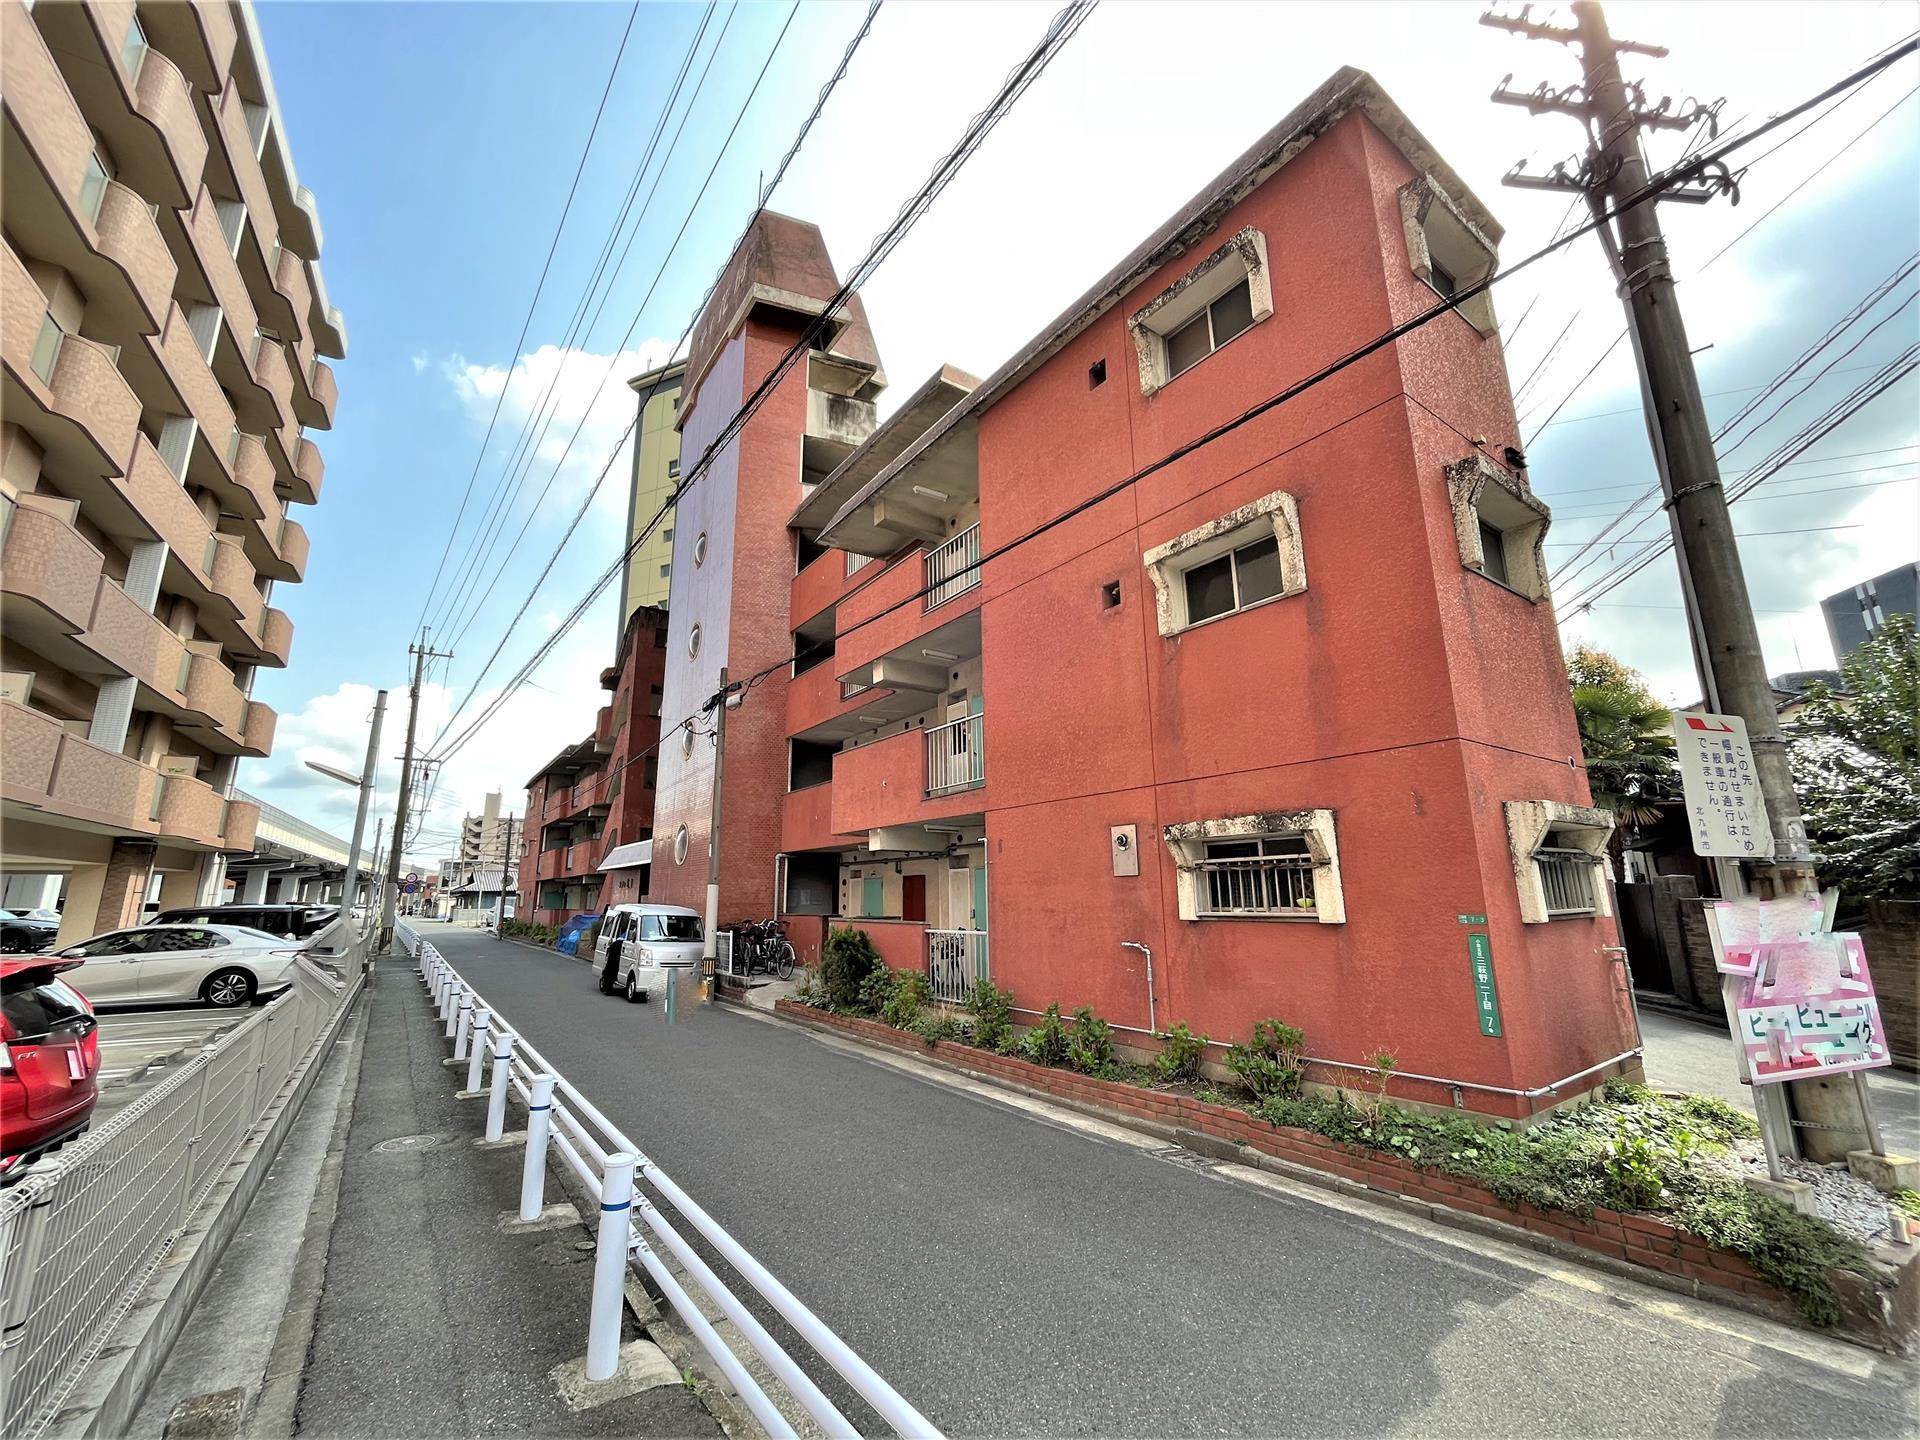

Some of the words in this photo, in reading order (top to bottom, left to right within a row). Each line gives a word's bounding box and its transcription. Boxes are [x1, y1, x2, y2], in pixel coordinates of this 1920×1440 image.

[1735, 745, 1753, 786] この先
[1721, 738, 1755, 851] 幅員がせまいため
[1696, 805, 1711, 850] 北九州市
